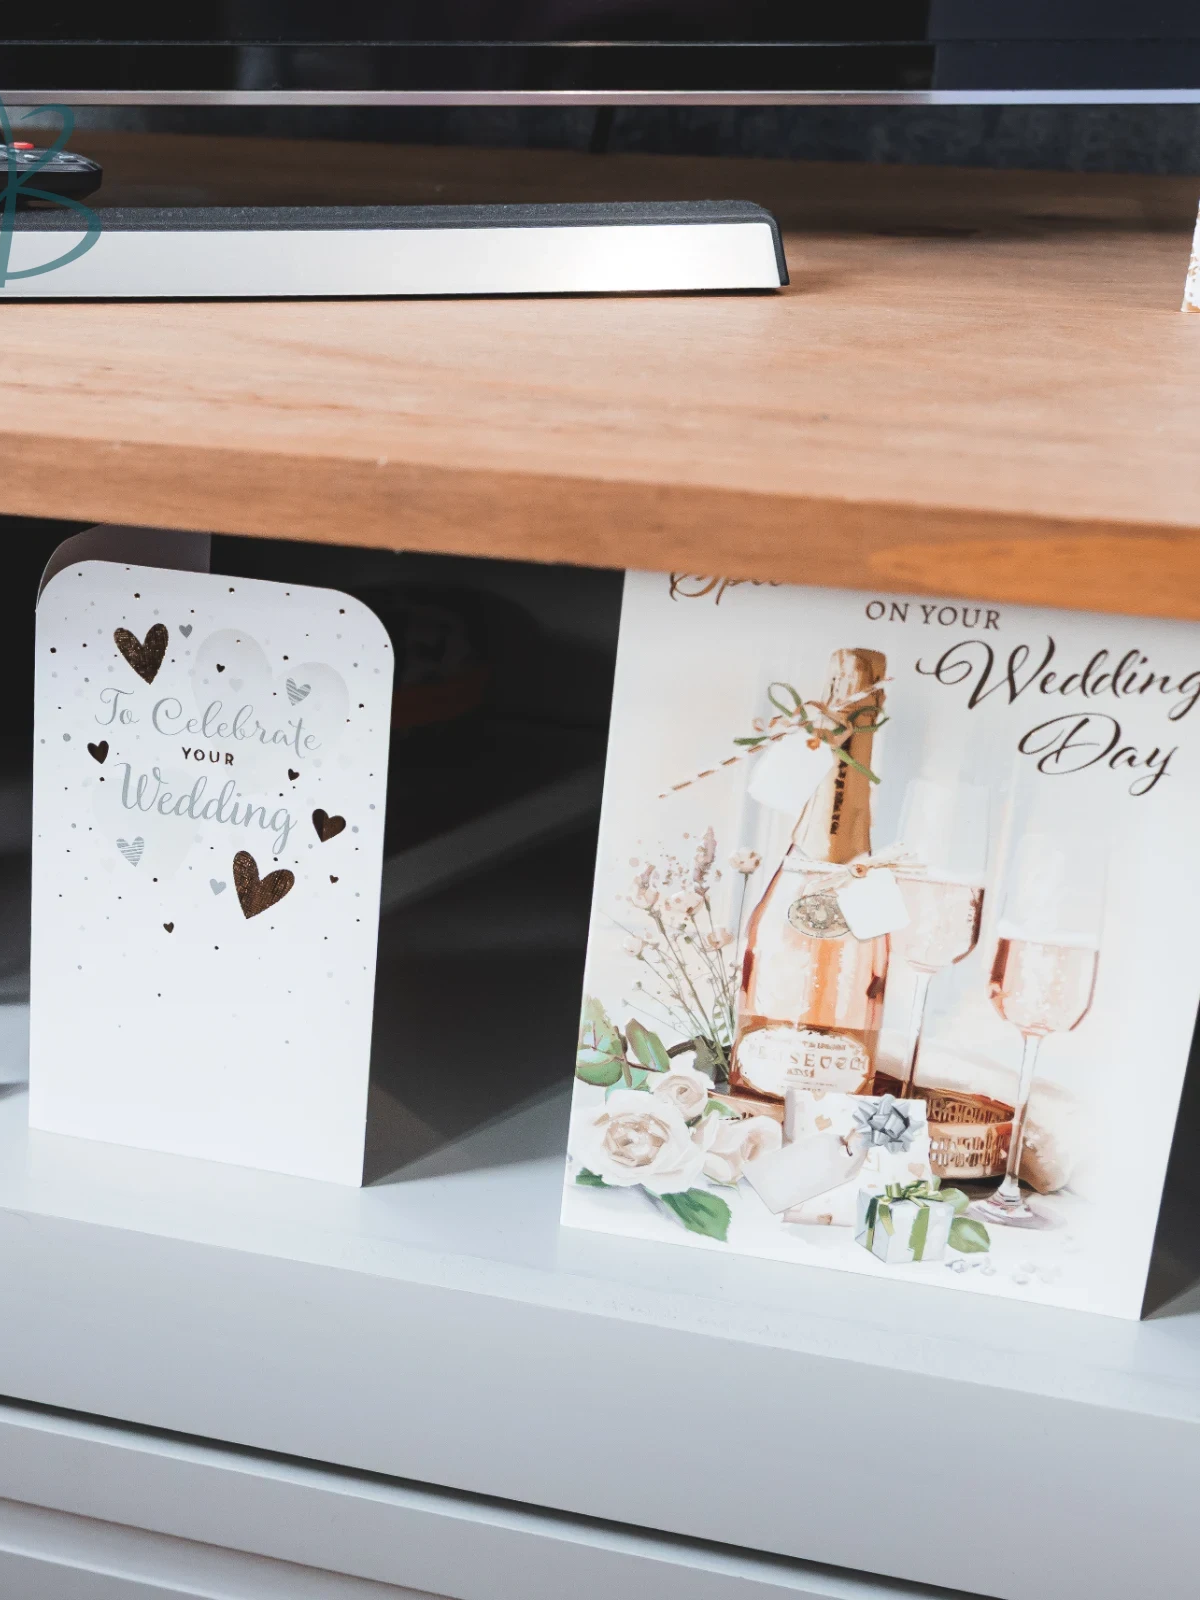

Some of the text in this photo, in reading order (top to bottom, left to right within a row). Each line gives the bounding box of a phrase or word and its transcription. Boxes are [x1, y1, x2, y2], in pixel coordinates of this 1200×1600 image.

[866, 600, 1000, 632] ON YOUR
[915, 635, 1200, 721] Wedding
[95, 687, 322, 759] To Celebrate
[181, 746, 235, 766] YOUR
[1018, 712, 1179, 797] Day
[114, 762, 297, 855] Wedding
